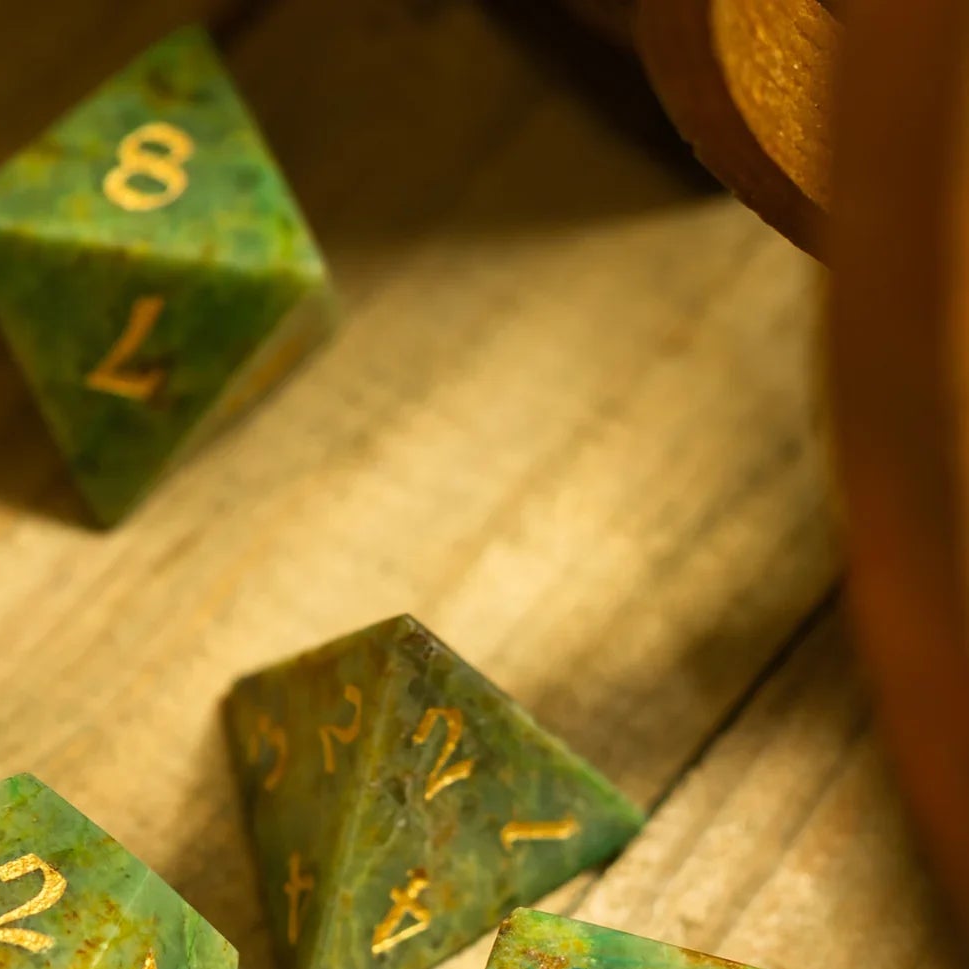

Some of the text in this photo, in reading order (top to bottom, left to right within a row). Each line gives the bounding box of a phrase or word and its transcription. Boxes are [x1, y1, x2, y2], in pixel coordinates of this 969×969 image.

[102, 120, 195, 211] 8
[86, 296, 165, 401] 7
[319, 685, 362, 773] 2
[412, 707, 477, 800] 2
[501, 816, 580, 850] 1
[371, 867, 430, 957] 4
